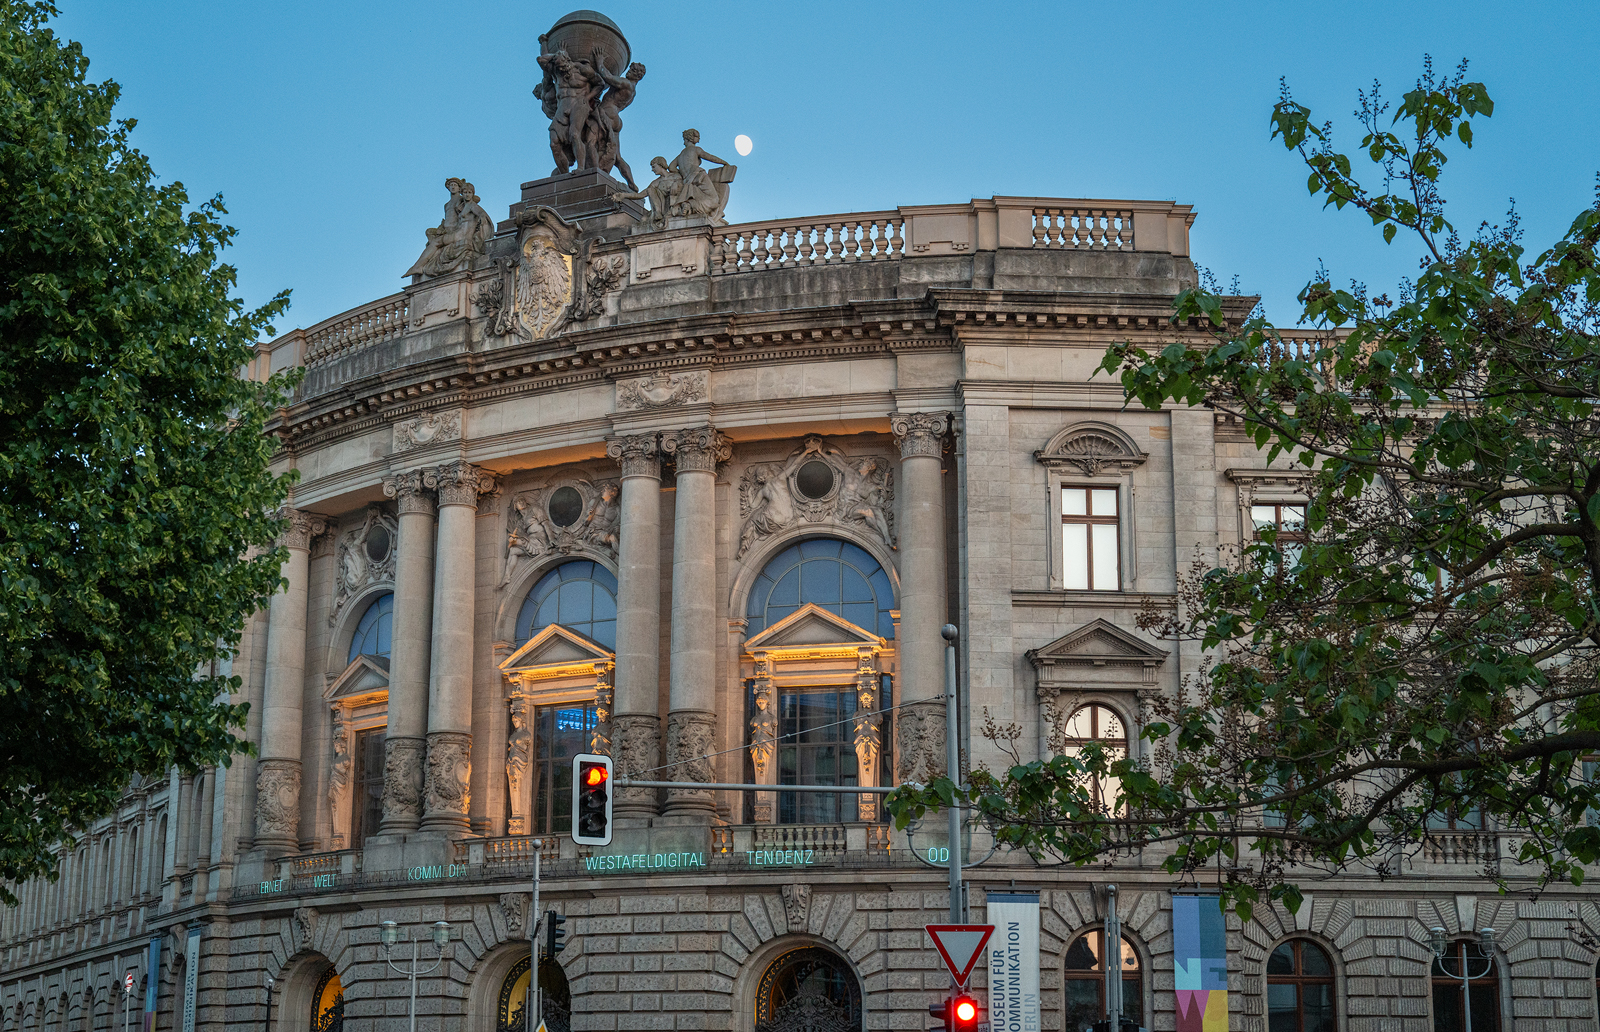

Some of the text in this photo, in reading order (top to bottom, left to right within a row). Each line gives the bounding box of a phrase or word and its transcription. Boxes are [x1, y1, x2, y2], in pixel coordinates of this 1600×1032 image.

[746, 849, 814, 865] TENDENZ
[313, 873, 337, 888] WELT
[990, 950, 1005, 975] FÜR
